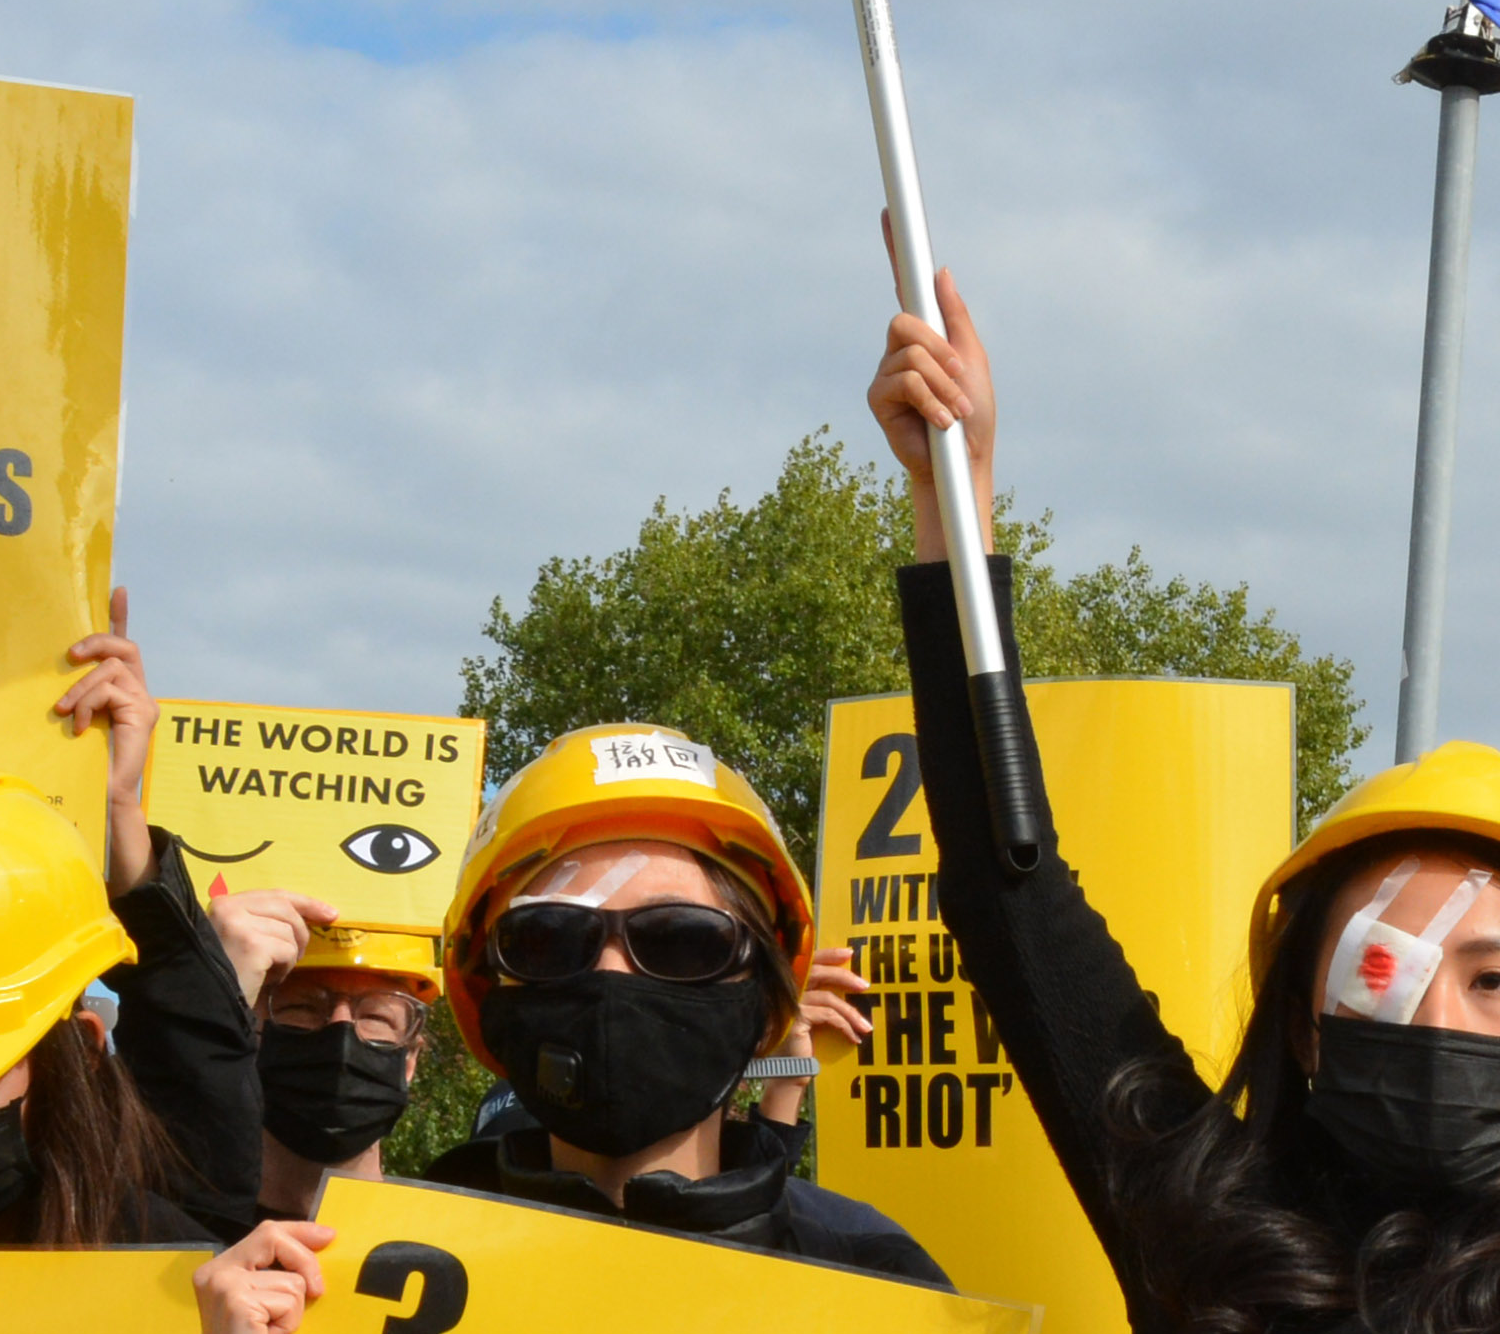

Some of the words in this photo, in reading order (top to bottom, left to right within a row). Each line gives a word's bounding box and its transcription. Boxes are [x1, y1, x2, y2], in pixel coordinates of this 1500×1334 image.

[171, 716, 242, 747] THE
[258, 722, 408, 759] WORLD
[425, 734, 459, 763] IS
[198, 765, 425, 807] WATCHING
[856, 732, 923, 860] 2
[847, 934, 918, 984] THE
[845, 991, 956, 1066] THE
